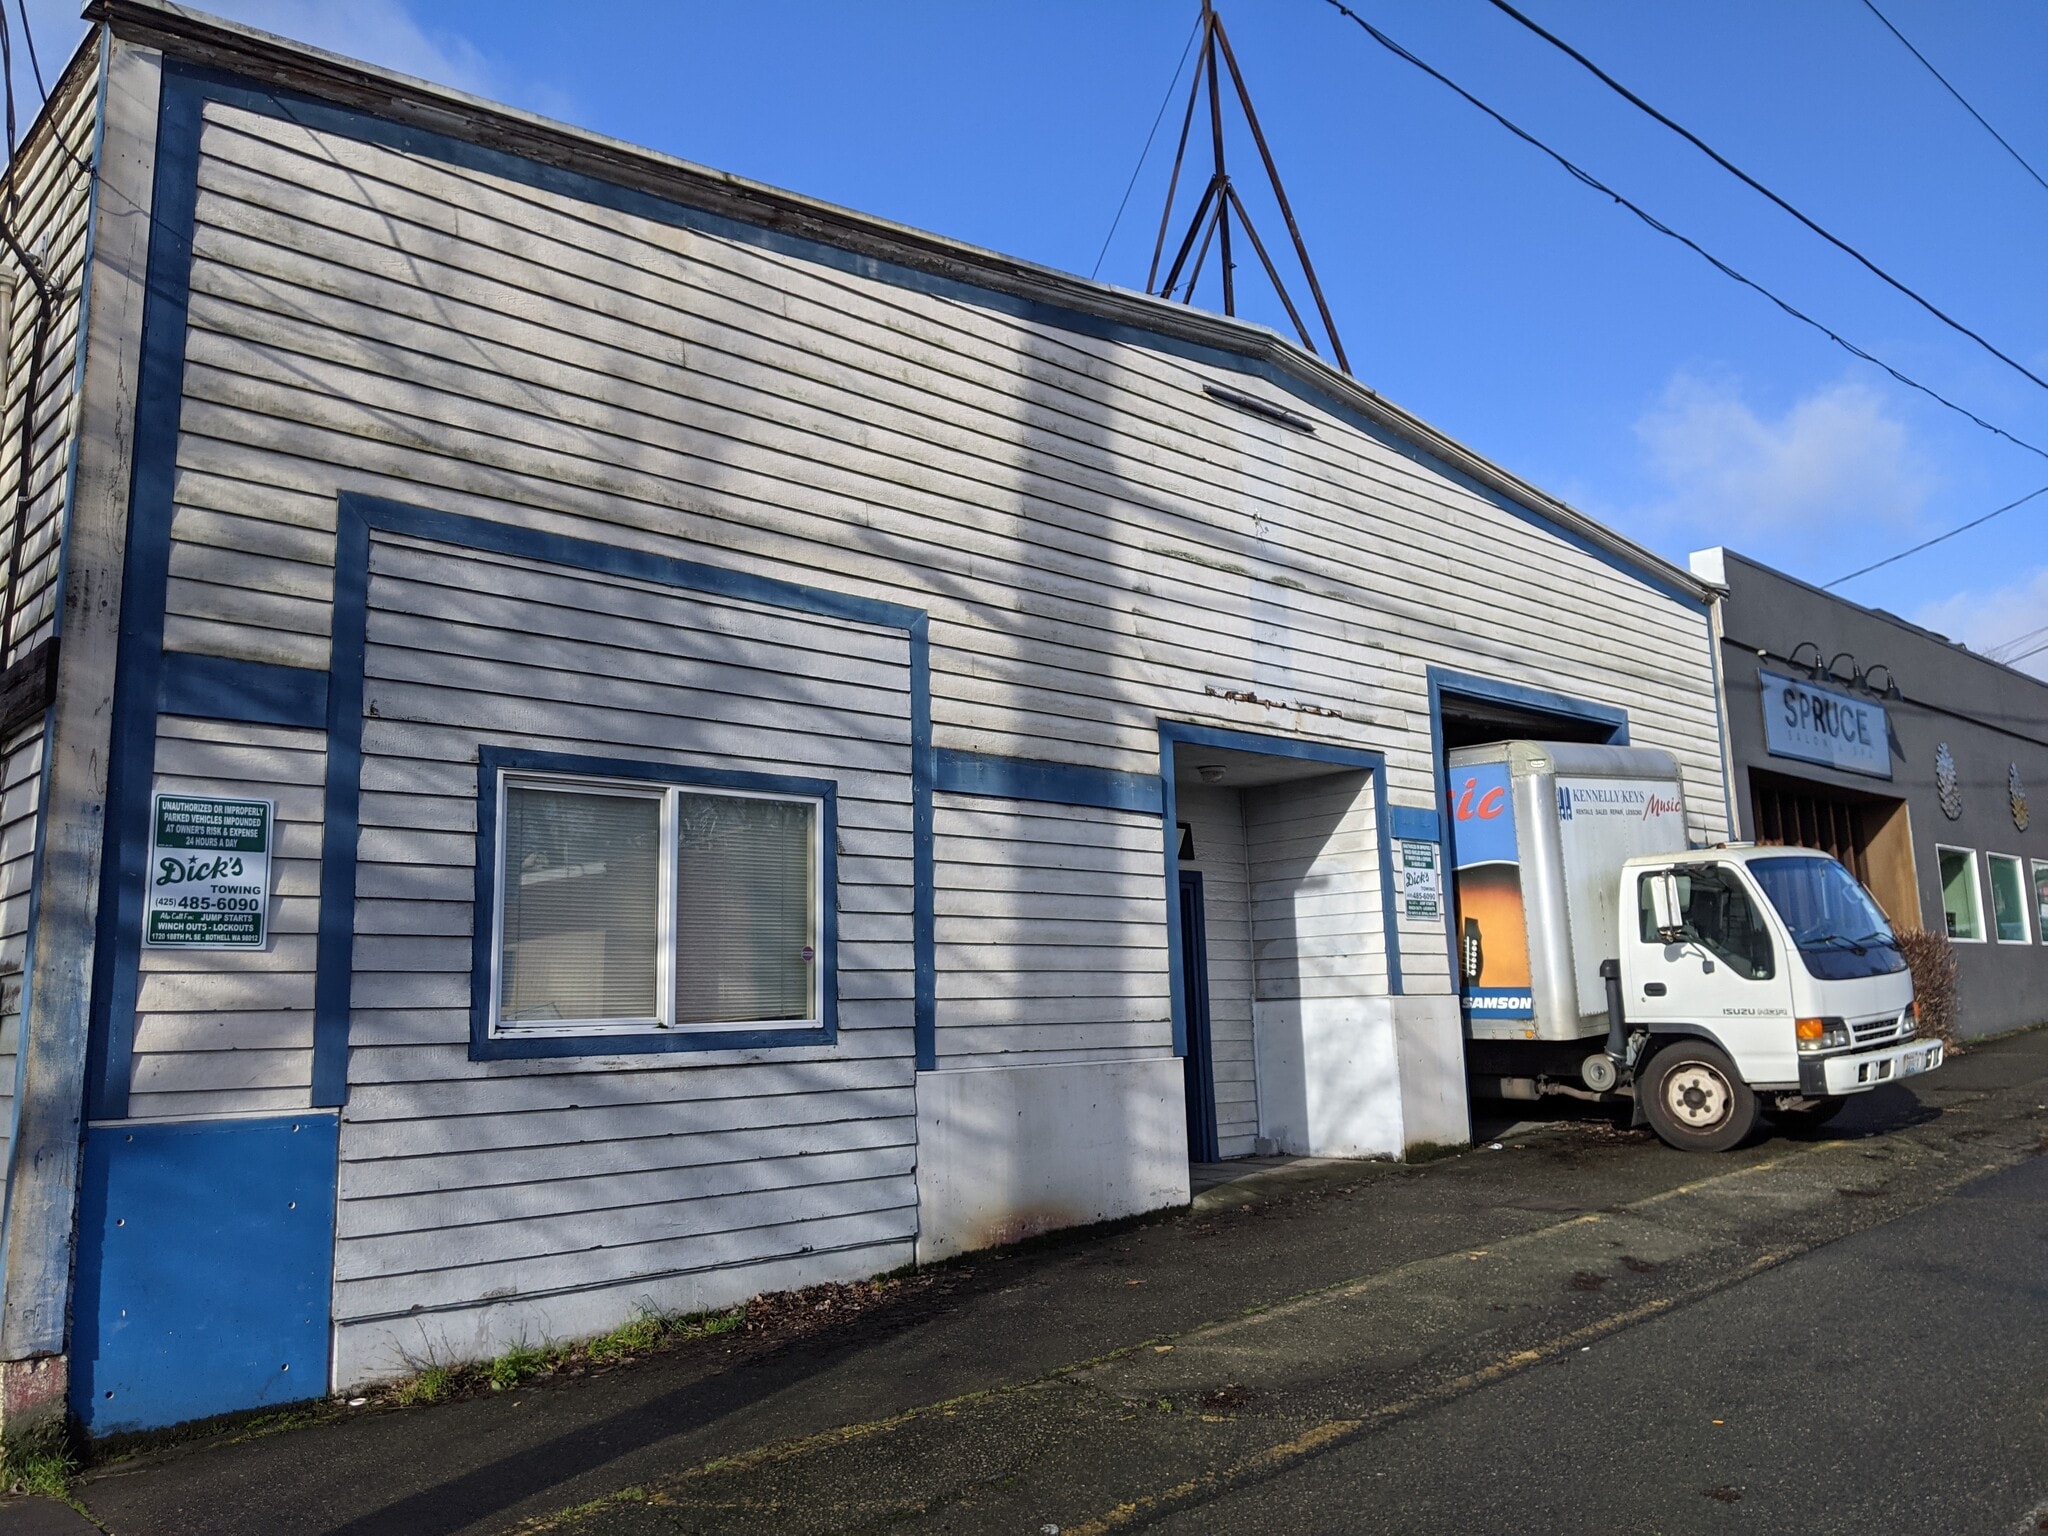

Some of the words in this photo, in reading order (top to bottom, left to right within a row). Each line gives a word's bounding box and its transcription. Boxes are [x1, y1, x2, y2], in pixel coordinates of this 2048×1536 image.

[1783, 688, 1871, 746] SPRUCE
[1573, 789, 1623, 803] KENNELLY
[1622, 790, 1645, 803] KEYS
[162, 801, 213, 813] UNAUTHORIZED
[214, 805, 223, 813] OR
[224, 806, 264, 816] IMPROPERLY
[1643, 793, 1681, 821] Music
[164, 813, 190, 823] PARKED
[191, 814, 223, 825] VEHICLES
[223, 817, 261, 827] IMPOUNDED
[166, 824, 174, 833] AT
[176, 824, 205, 835] OWNER'S
[206, 826, 221, 835] RISK
[223, 828, 228, 836] &
[229, 828, 258, 837] EXPENSE
[185, 836, 193, 845] 24
[195, 837, 217, 847] HOURS
[219, 838, 223, 846] A
[225, 839, 238, 847] DAY
[156, 855, 244, 886] Dick's
[1406, 871, 1429, 888] Dick's
[210, 885, 261, 894] TOWING
[155, 898, 177, 908] (425)
[178, 896, 259, 911] 485-6090
[172, 912, 184, 920] Call
[200, 913, 222, 921] JUMP
[158, 922, 184, 930] WINCH
[186, 923, 207, 931] OUTS
[213, 924, 254, 932] LOCKOUTS
[1462, 997, 1532, 1009] SAMSON
